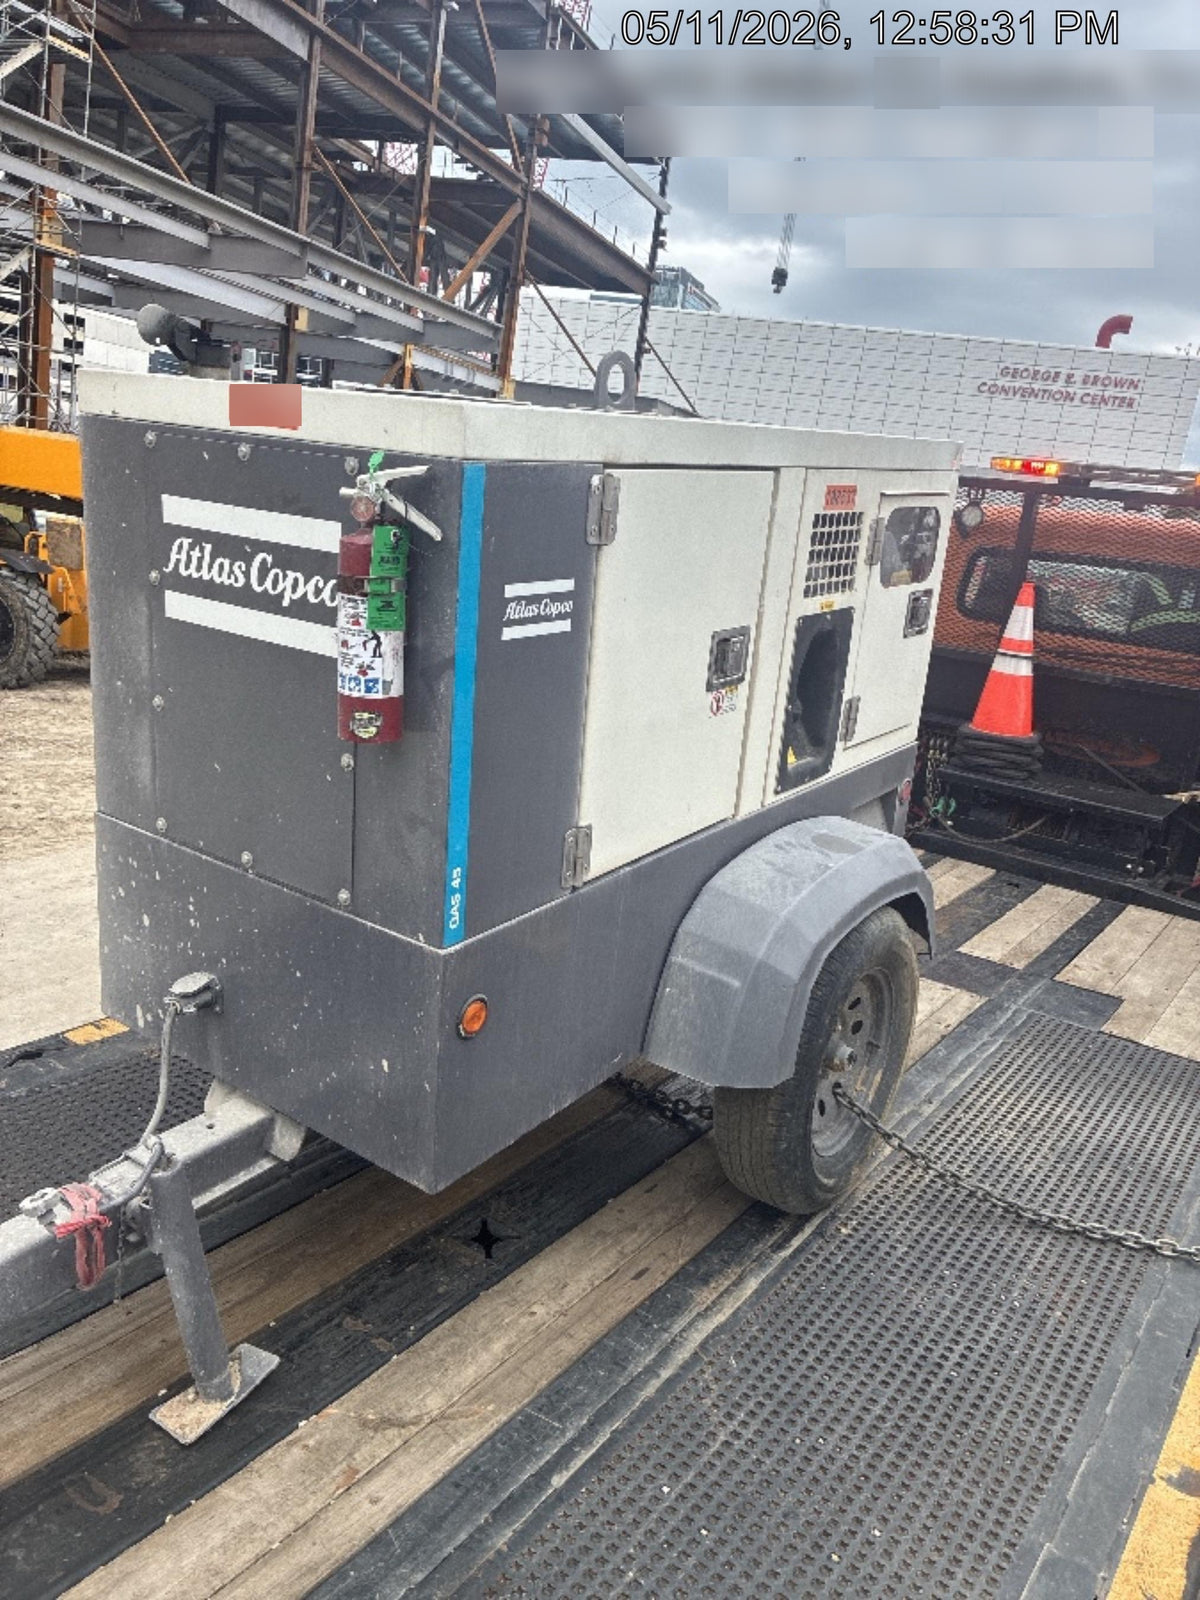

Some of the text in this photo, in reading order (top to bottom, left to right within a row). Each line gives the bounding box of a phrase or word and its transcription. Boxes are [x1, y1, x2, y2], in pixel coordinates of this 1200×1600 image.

[1000, 365, 1062, 383] GEORGE
[1081, 374, 1140, 390] BROWN
[977, 381, 1136, 409] CONVENTION CENTER
[162, 536, 247, 588] Atlas
[250, 552, 338, 607] Copco
[502, 597, 574, 621] Atlas Copco
